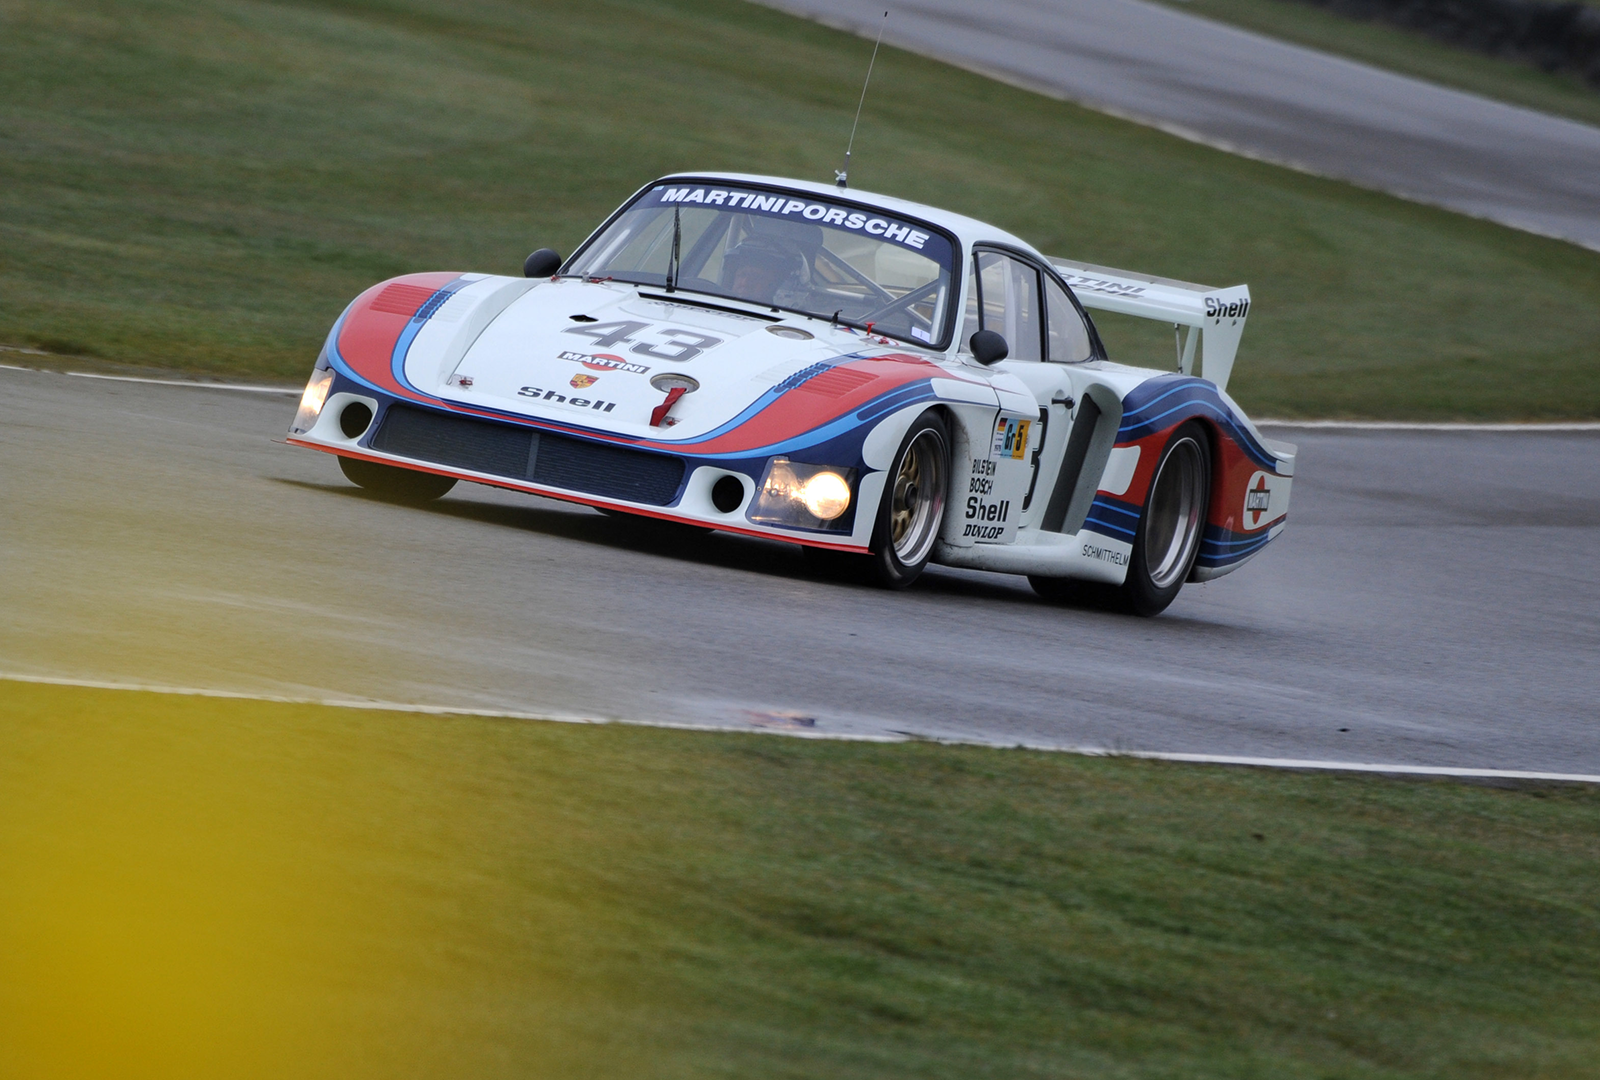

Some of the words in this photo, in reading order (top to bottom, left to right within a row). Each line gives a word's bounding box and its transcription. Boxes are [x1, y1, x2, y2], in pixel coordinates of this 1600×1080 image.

[660, 188, 929, 249] MARTINIPORSCHE
[1204, 297, 1249, 318] Shell
[560, 320, 724, 363] 43
[562, 352, 646, 374] MARTINI
[517, 386, 617, 412] Shell
[971, 459, 997, 476] BILSTEIN
[969, 478, 994, 495] BOSCH
[965, 497, 1010, 522] Shell
[963, 524, 1005, 539] DUNLOP
[1082, 544, 1130, 567] SCHMITTHELM
